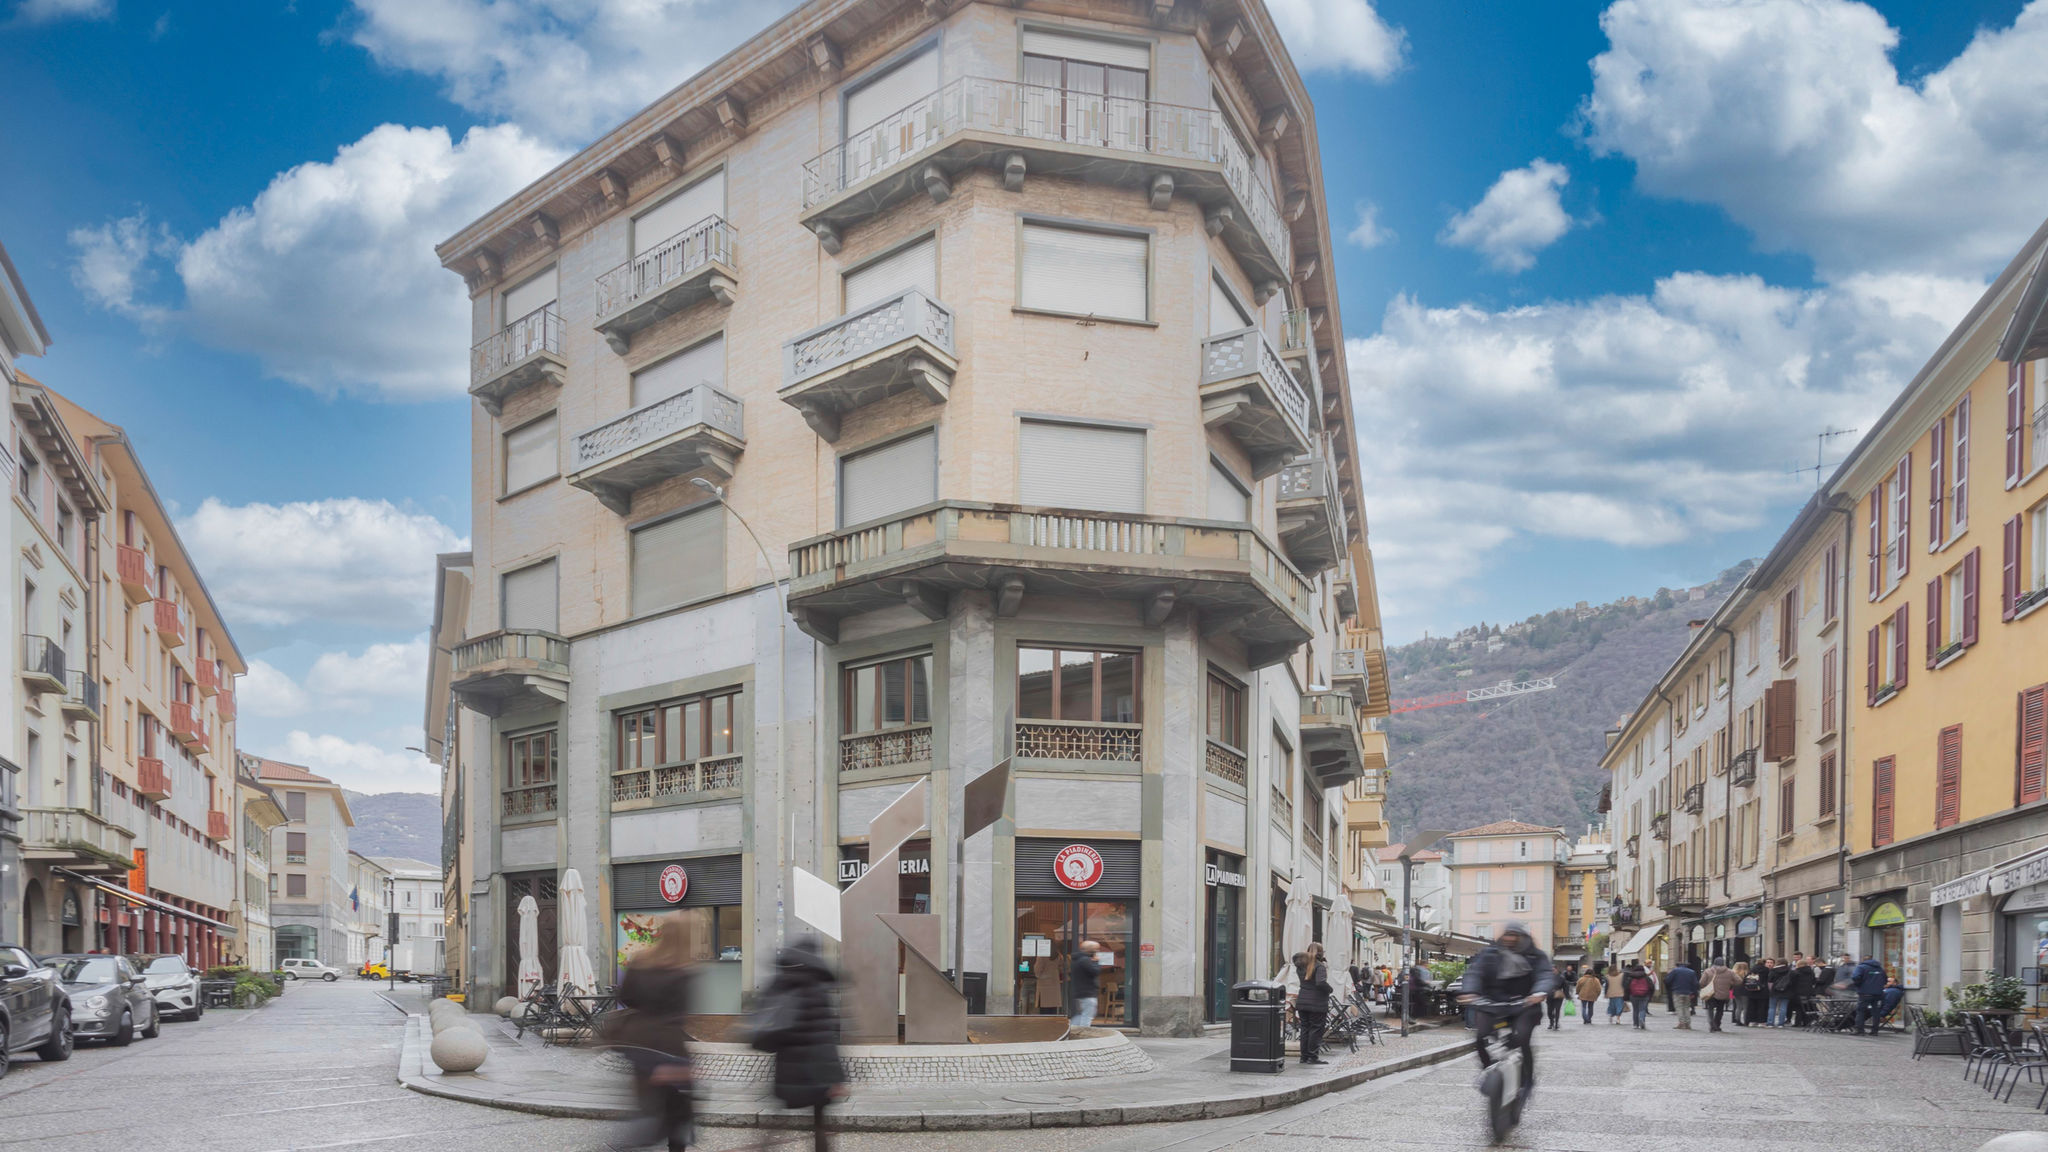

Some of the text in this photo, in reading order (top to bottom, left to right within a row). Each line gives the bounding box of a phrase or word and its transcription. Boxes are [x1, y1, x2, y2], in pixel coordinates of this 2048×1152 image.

[1058, 846, 1100, 864] LA PIADINERIA
[841, 858, 930, 878] LA PERIA
[1207, 867, 1246, 887] LA PIADINERIA
